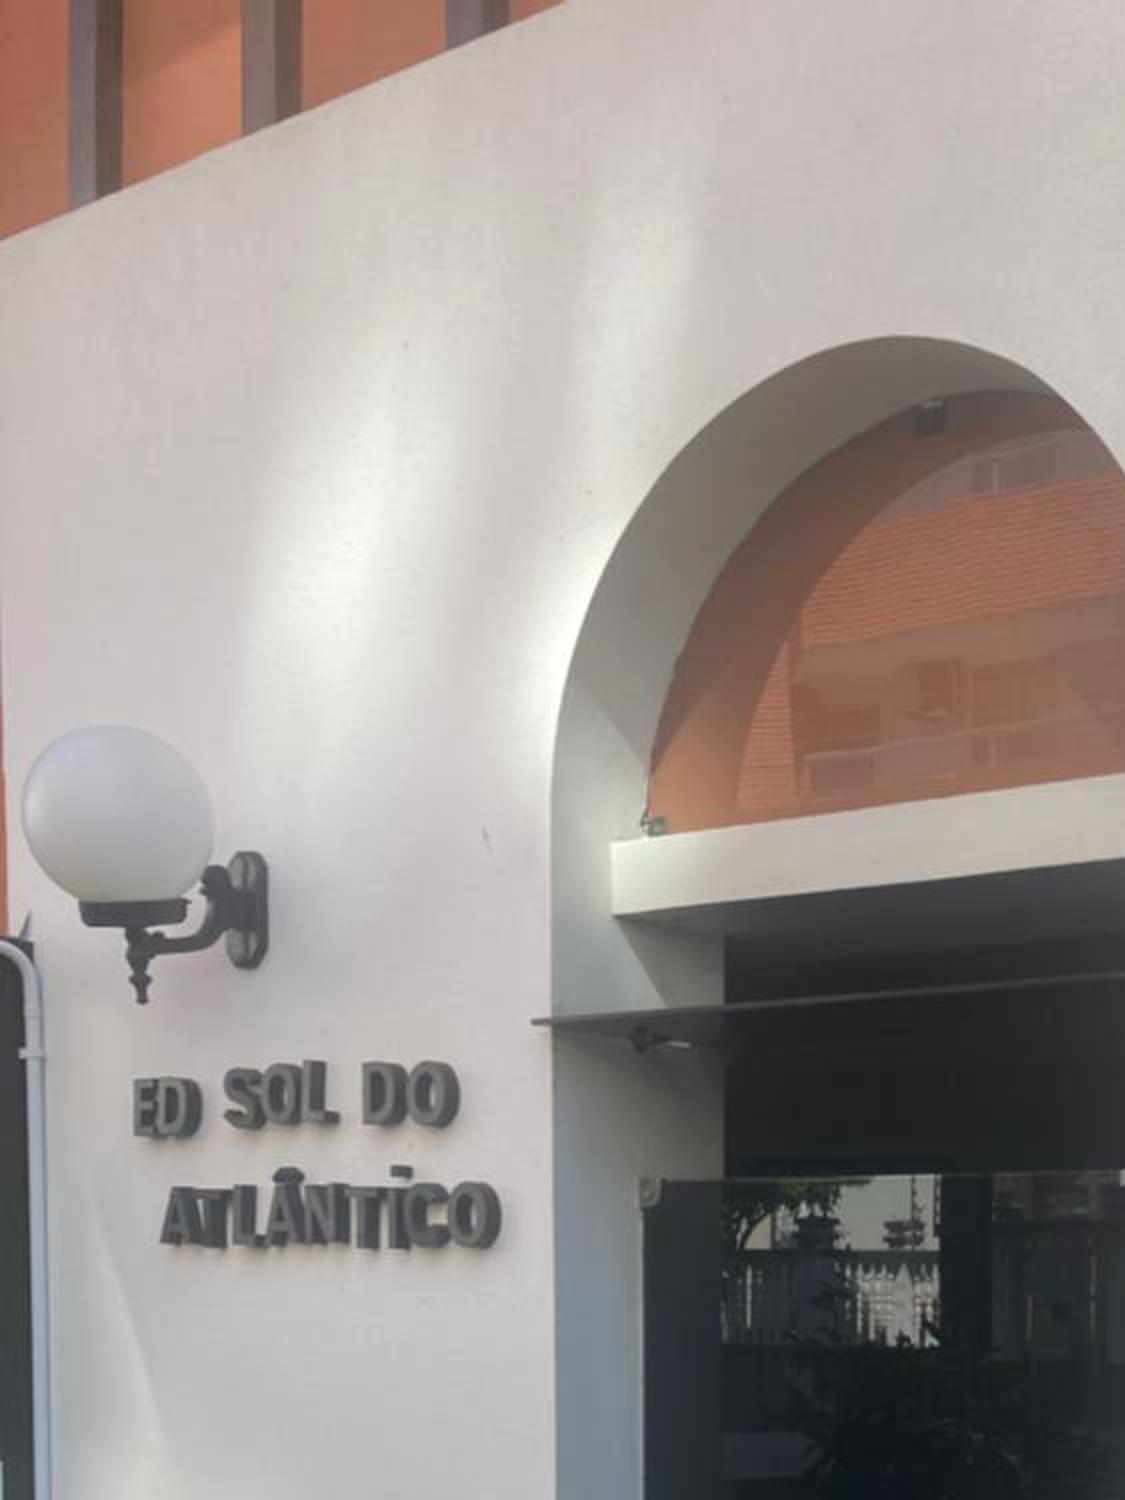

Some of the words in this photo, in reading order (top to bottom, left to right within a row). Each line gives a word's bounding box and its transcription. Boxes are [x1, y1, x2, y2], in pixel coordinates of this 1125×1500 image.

[133, 1076, 203, 1138] ED
[223, 1060, 341, 1130] SOL
[361, 1060, 461, 1129] DO
